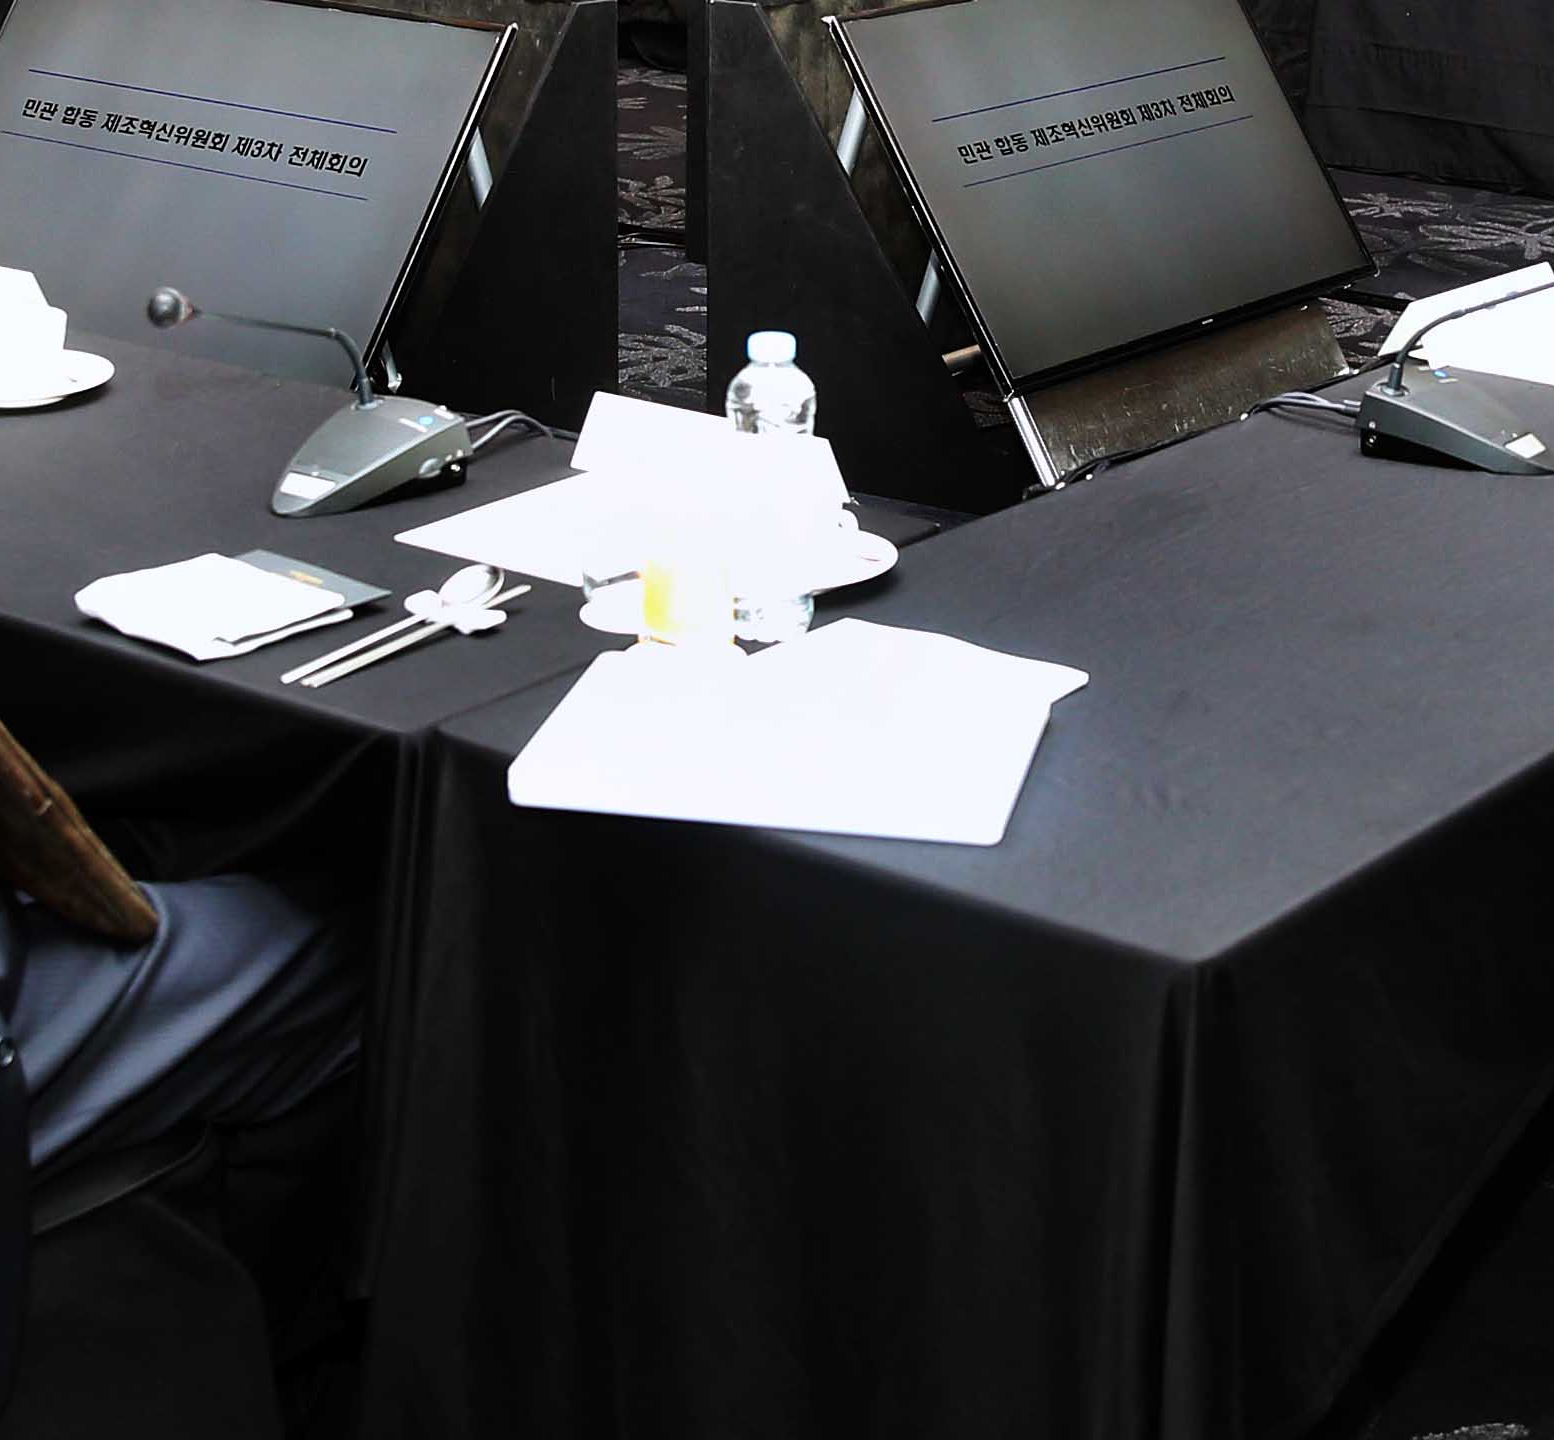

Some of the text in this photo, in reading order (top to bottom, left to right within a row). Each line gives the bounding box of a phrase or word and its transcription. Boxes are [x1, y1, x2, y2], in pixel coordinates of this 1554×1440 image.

[21, 98, 368, 178] 민관 합동 제조혁신위원회 제3차 전체회의
[957, 85, 1235, 165] 민관 합동 제조혁신위원회 제3차 전체회의
